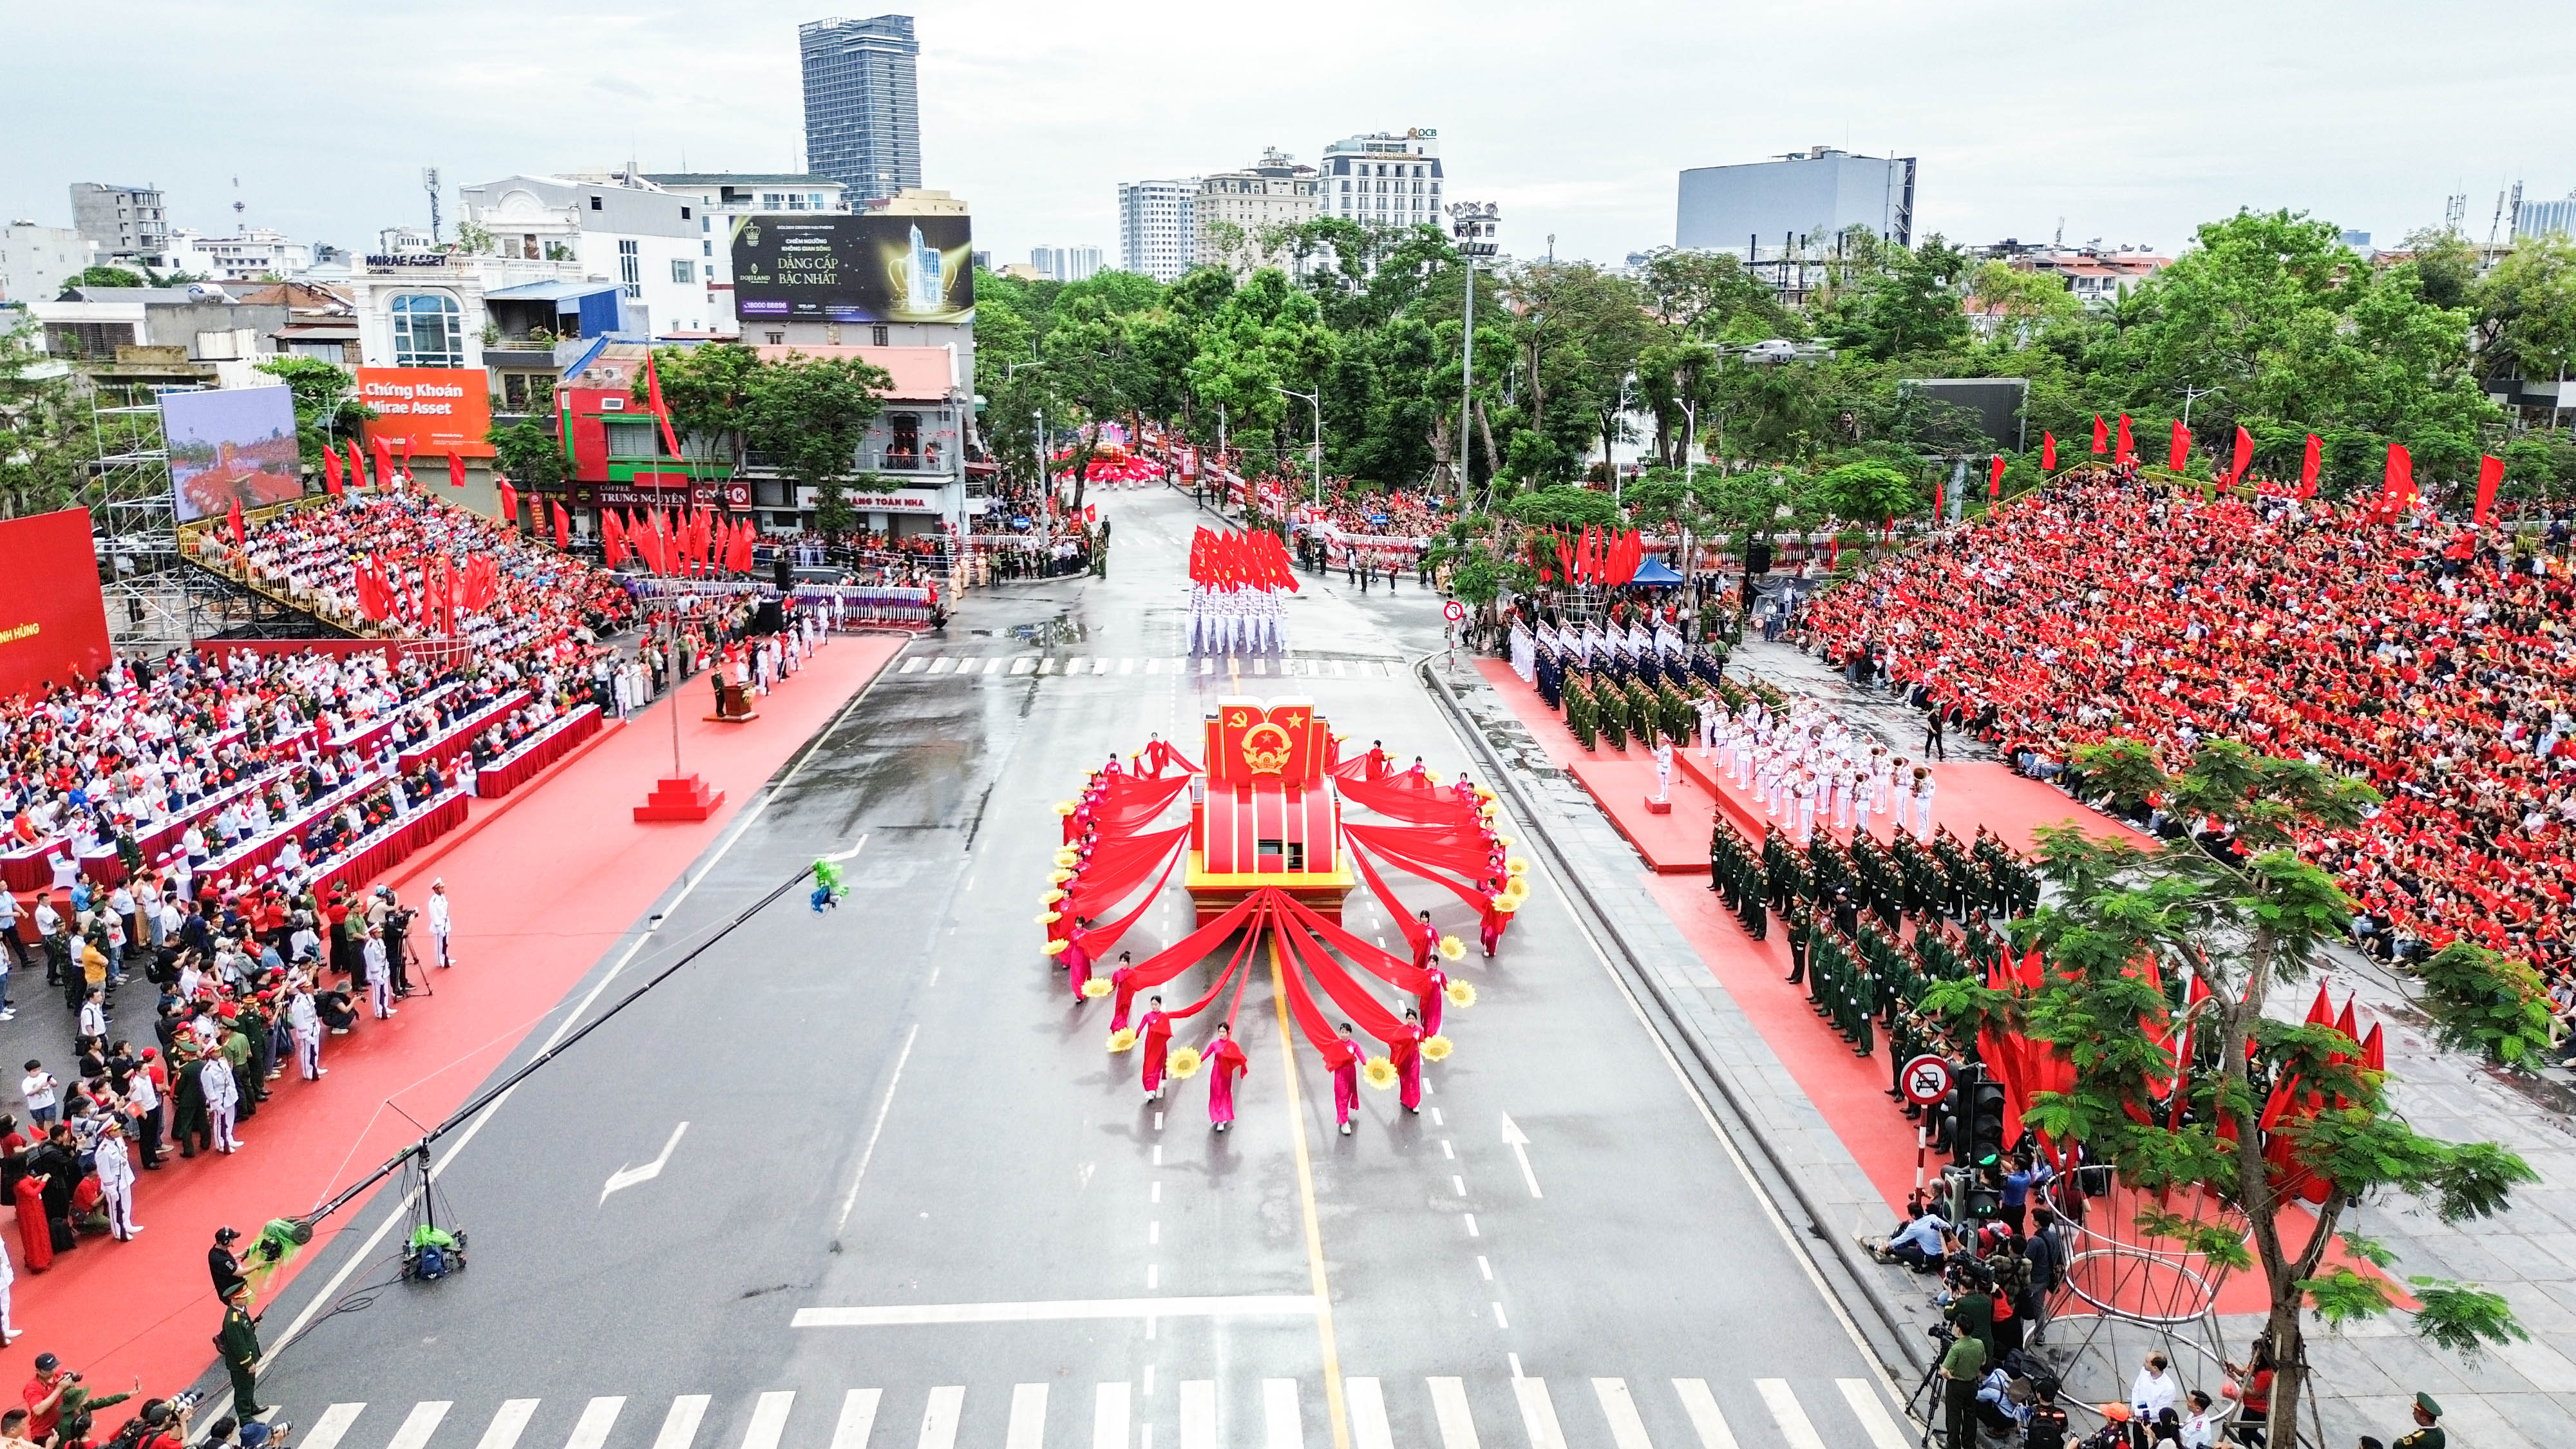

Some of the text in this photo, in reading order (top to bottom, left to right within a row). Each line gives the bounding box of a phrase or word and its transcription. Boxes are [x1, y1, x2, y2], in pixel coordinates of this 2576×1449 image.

[366, 256, 407, 266] MIRAE
[815, 253, 838, 269] CẤP
[779, 269, 838, 286] BẬC NHẤT
[365, 383, 462, 399] Chứng Khoán
[367, 401, 452, 414] Mirae Asset
[600, 493, 638, 502] TRUNG
[640, 492, 687, 503] NGUYÊN
